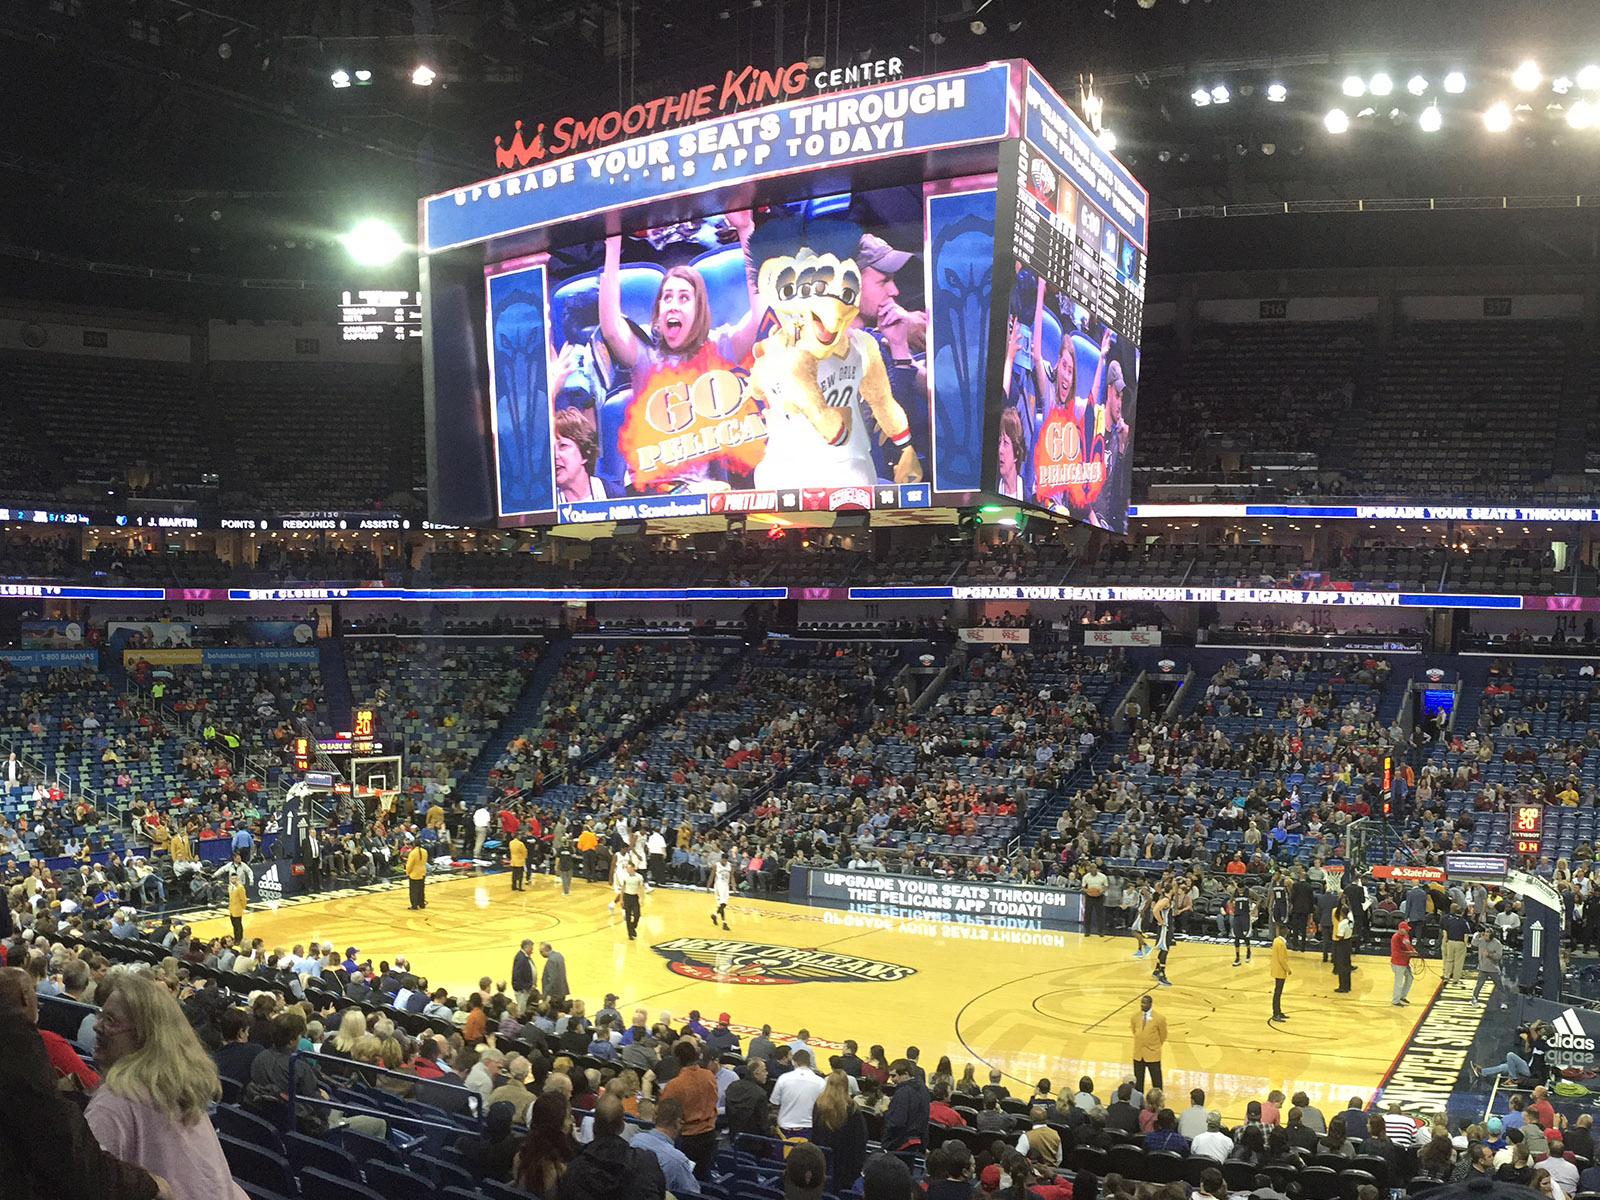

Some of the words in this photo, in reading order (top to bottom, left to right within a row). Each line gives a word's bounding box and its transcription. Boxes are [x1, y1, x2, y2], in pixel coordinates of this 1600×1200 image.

[549, 83, 720, 154] SMOOTHIE
[814, 57, 902, 89] CENTER
[454, 162, 575, 206] UPGRADE
[586, 139, 670, 178] YOUR
[678, 114, 780, 157] SEATS
[790, 79, 965, 134] THROUGH
[712, 144, 771, 172] APP
[786, 120, 904, 158] TODAY!
[645, 369, 744, 434] GO
[1045, 422, 1080, 462] GO
[1358, 506, 1425, 519] UPGRADE
[1429, 507, 1468, 519] YOUR
[1471, 508, 1517, 520] SEATS
[1521, 508, 1592, 520] THROUGH
[159, 518, 197, 528] MARTIN
[221, 520, 255, 529] POINTS
[283, 520, 336, 529] REBOUNDS
[360, 520, 399, 529] ASSISTS
[952, 588, 1018, 599] UPGRADE
[1021, 588, 1060, 600] YOUR
[1062, 588, 1110, 600] SEATS
[1114, 588, 1184, 601] THROUGH
[1192, 590, 1220, 602] THE
[1226, 590, 1302, 604] PELICANS
[1308, 592, 1338, 604] APP
[1342, 593, 1400, 606] TODAY!
[1310, 610, 1331, 624] 113
[355, 720, 371, 735] 20
[1518, 818, 1534, 829] 20
[258, 880, 282, 891] adidas
[823, 873, 894, 891] UPGRADE
[898, 878, 939, 897] YOUR
[942, 882, 990, 900] SEATS
[992, 887, 1066, 906] THROUGH
[848, 888, 877, 902] THE
[880, 890, 953, 910] PELICANS
[955, 898, 985, 913] APP
[989, 902, 1043, 918] TODAY!
[664, 938, 755, 954] NEW
[758, 947, 917, 982] ORLEANS
[1546, 1032, 1595, 1050] didas
[1376, 1046, 1468, 1114] PELICANS
